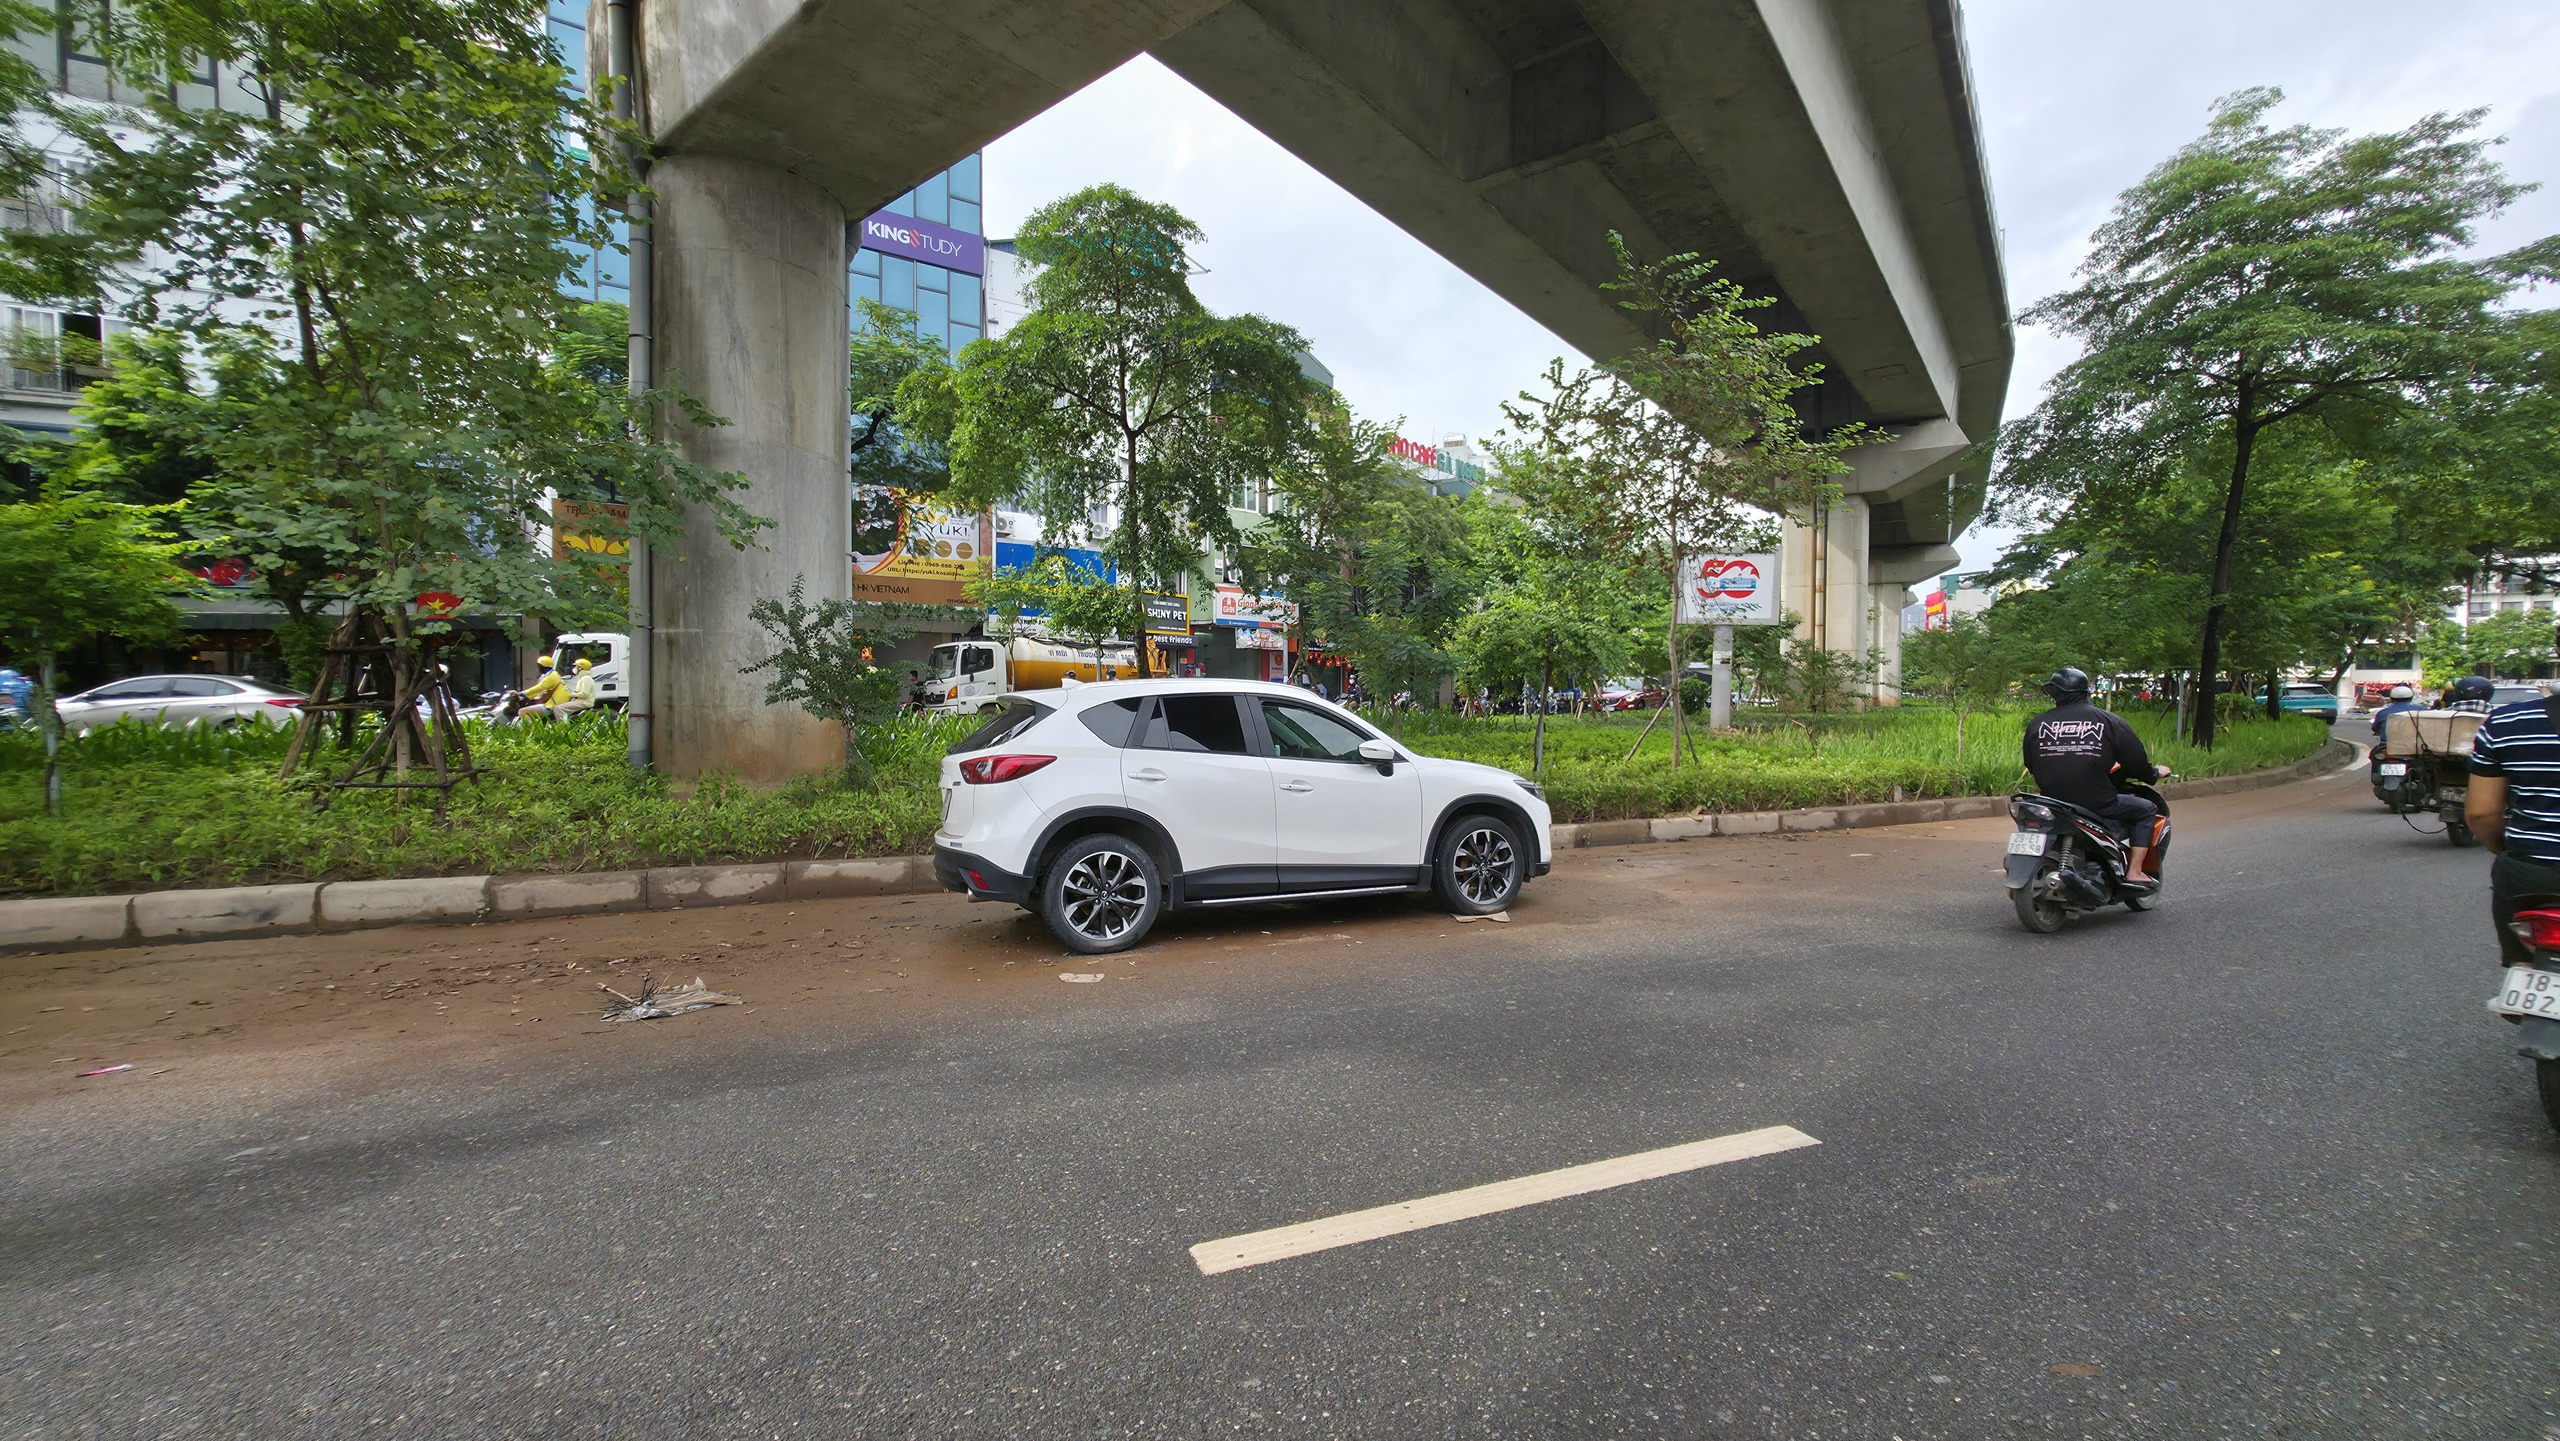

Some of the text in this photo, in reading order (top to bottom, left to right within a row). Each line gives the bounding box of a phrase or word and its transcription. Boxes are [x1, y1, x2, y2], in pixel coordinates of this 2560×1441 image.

[926, 523, 968, 537] YUKI
[870, 584, 910, 594] VIETNAM
[1147, 608, 1187, 620] SHINY PET
[1154, 635, 1168, 643] best
[1169, 636, 1193, 644] friends
